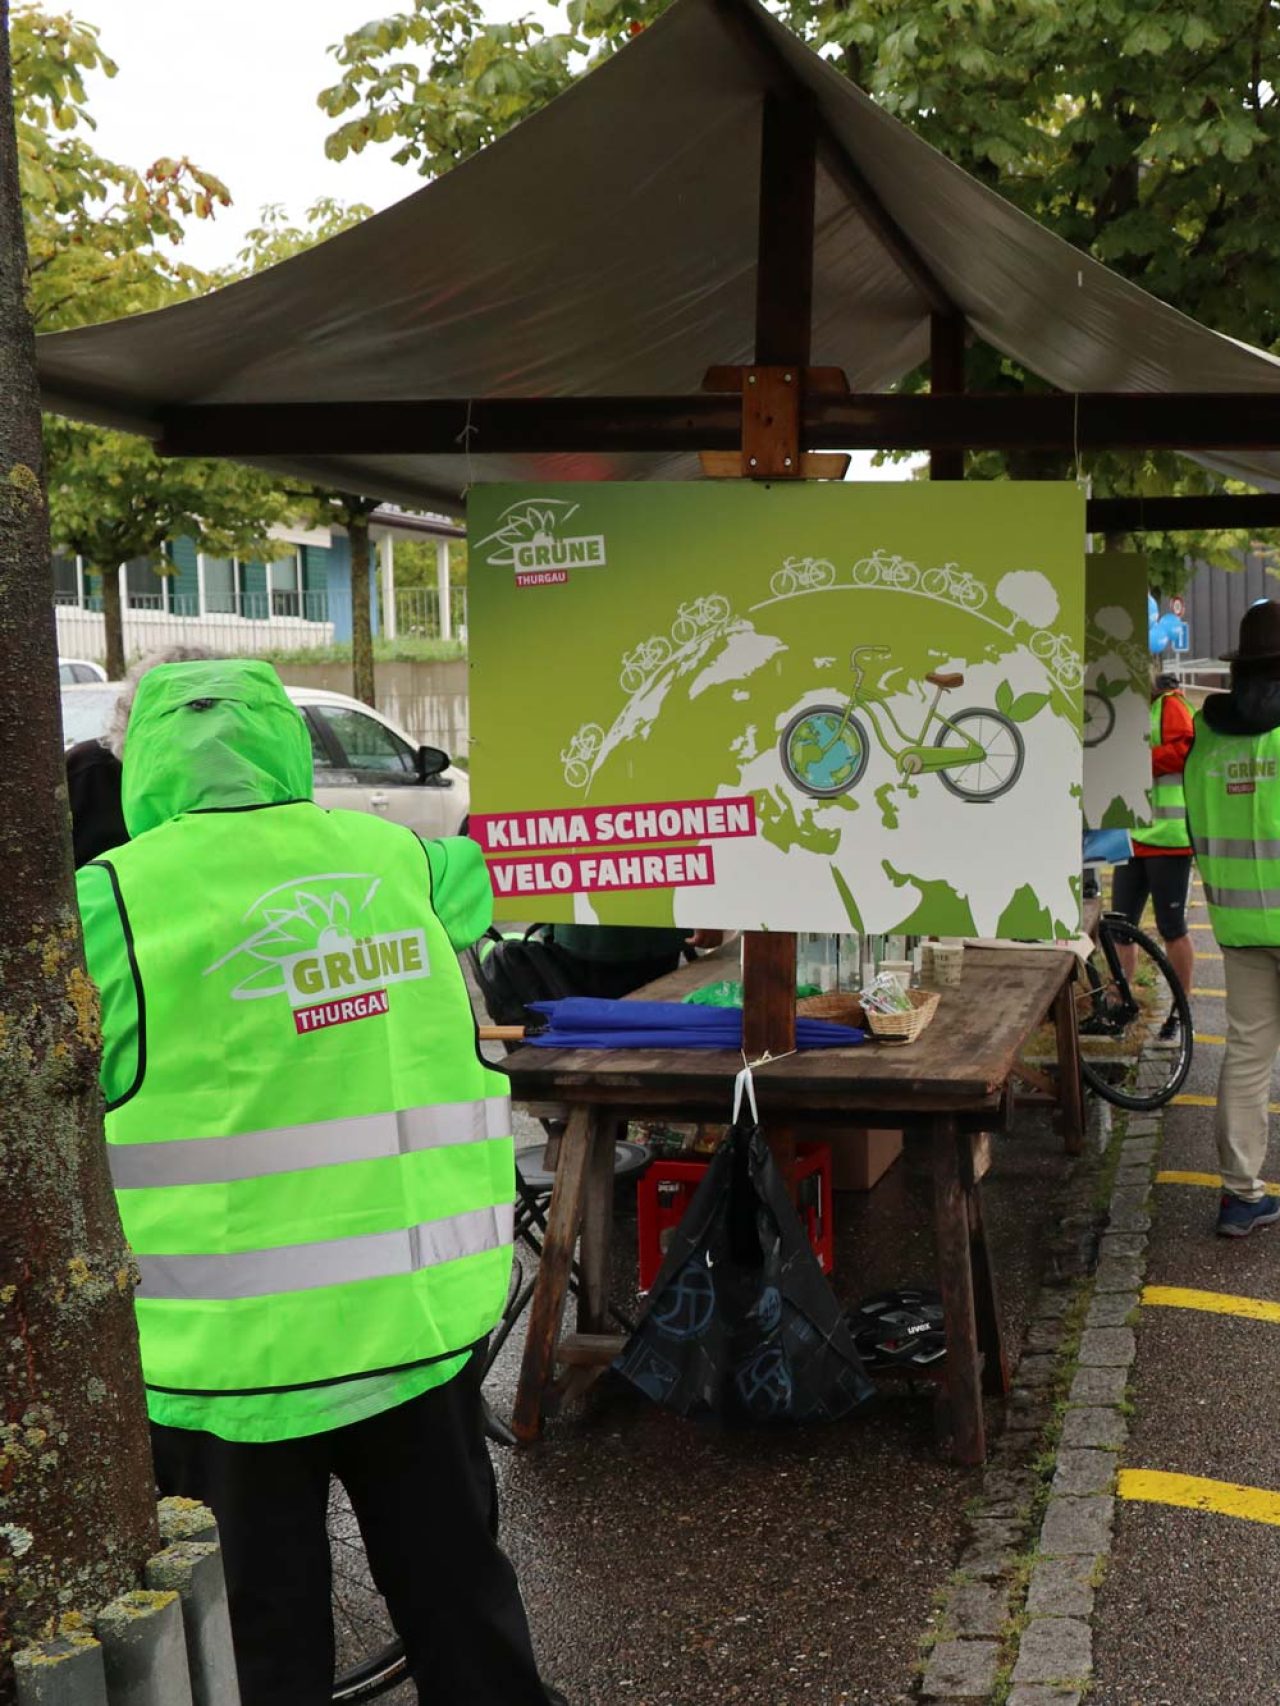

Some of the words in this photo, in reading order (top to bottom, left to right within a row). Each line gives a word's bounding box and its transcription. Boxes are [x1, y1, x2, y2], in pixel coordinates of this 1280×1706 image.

[518, 539, 600, 567] GRÜNE
[517, 572, 566, 586] THURGAU
[486, 815, 591, 848] KLIMA
[594, 803, 750, 841] SCHONEN
[493, 860, 573, 892] VELO
[579, 853, 709, 887] FAHREN
[292, 936, 423, 994] GRÜNE
